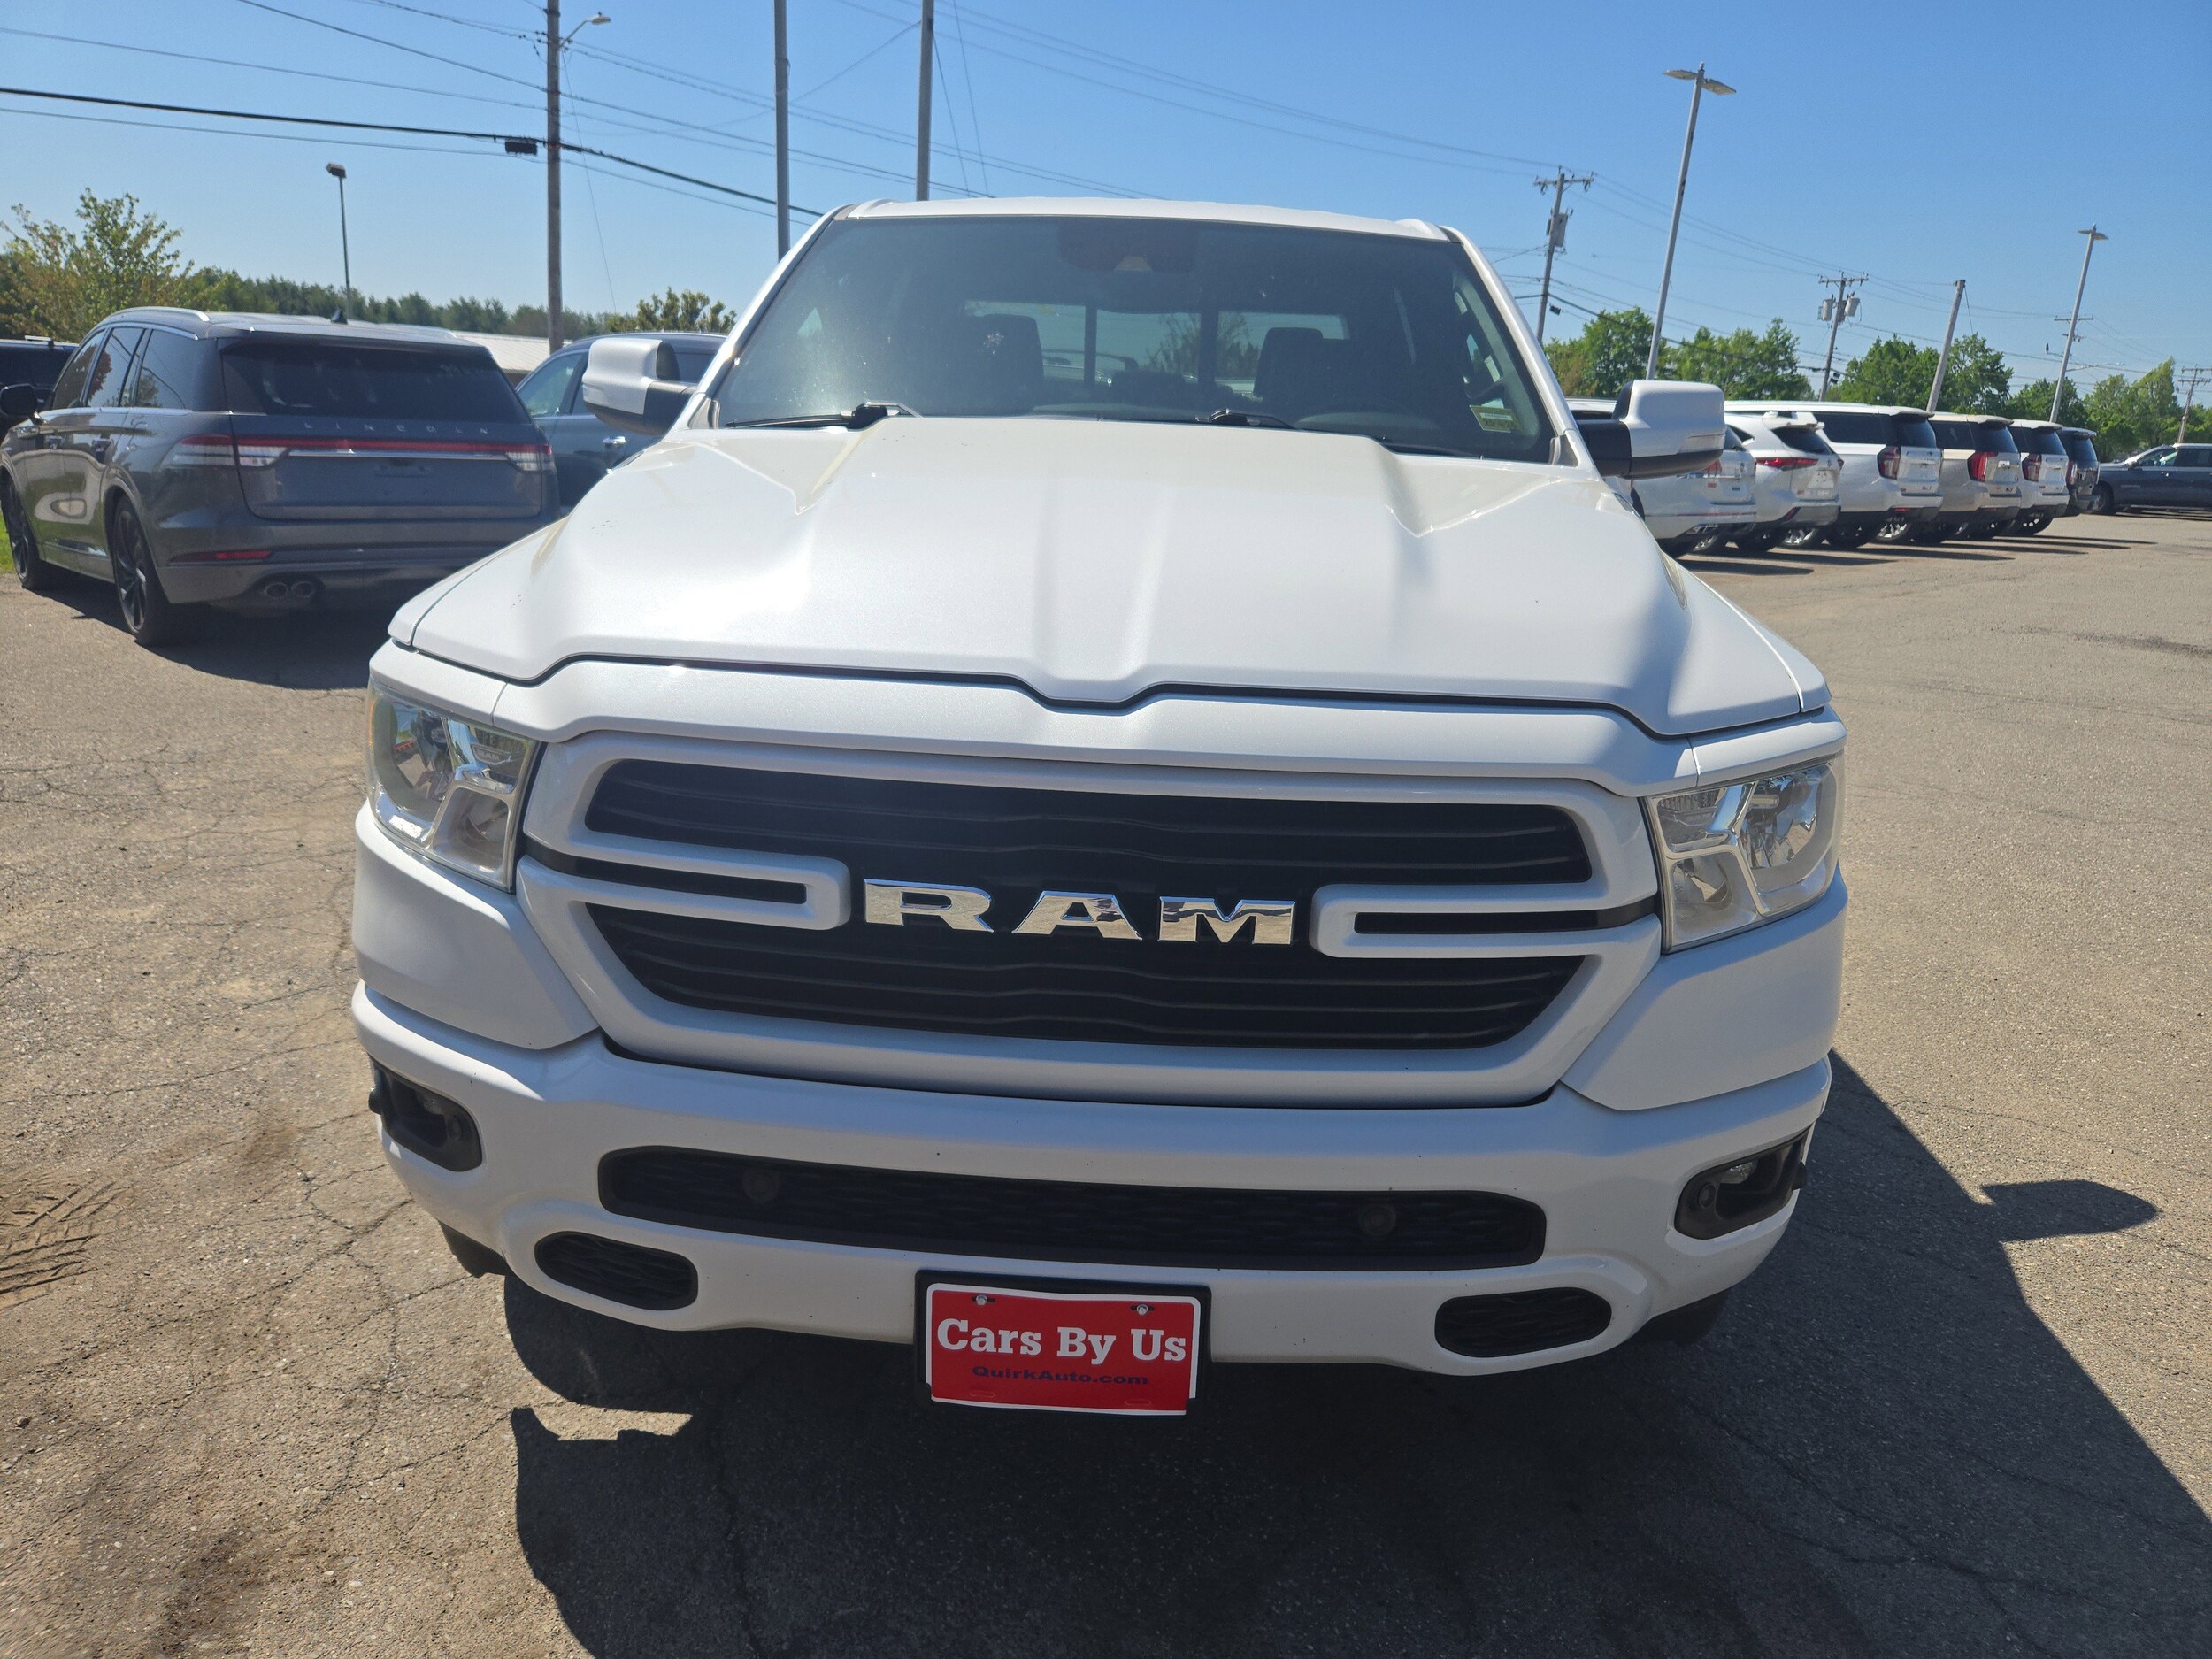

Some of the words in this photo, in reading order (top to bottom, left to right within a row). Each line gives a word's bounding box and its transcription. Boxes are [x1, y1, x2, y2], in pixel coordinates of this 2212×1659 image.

[303, 421, 488, 434] LINCOLN
[863, 878, 1296, 945] RAM
[937, 1318, 1041, 1356] Cars
[1056, 1326, 1116, 1365] By
[1131, 1328, 1187, 1362] Us
[972, 1365, 1148, 1386] QuirkAuto.com
